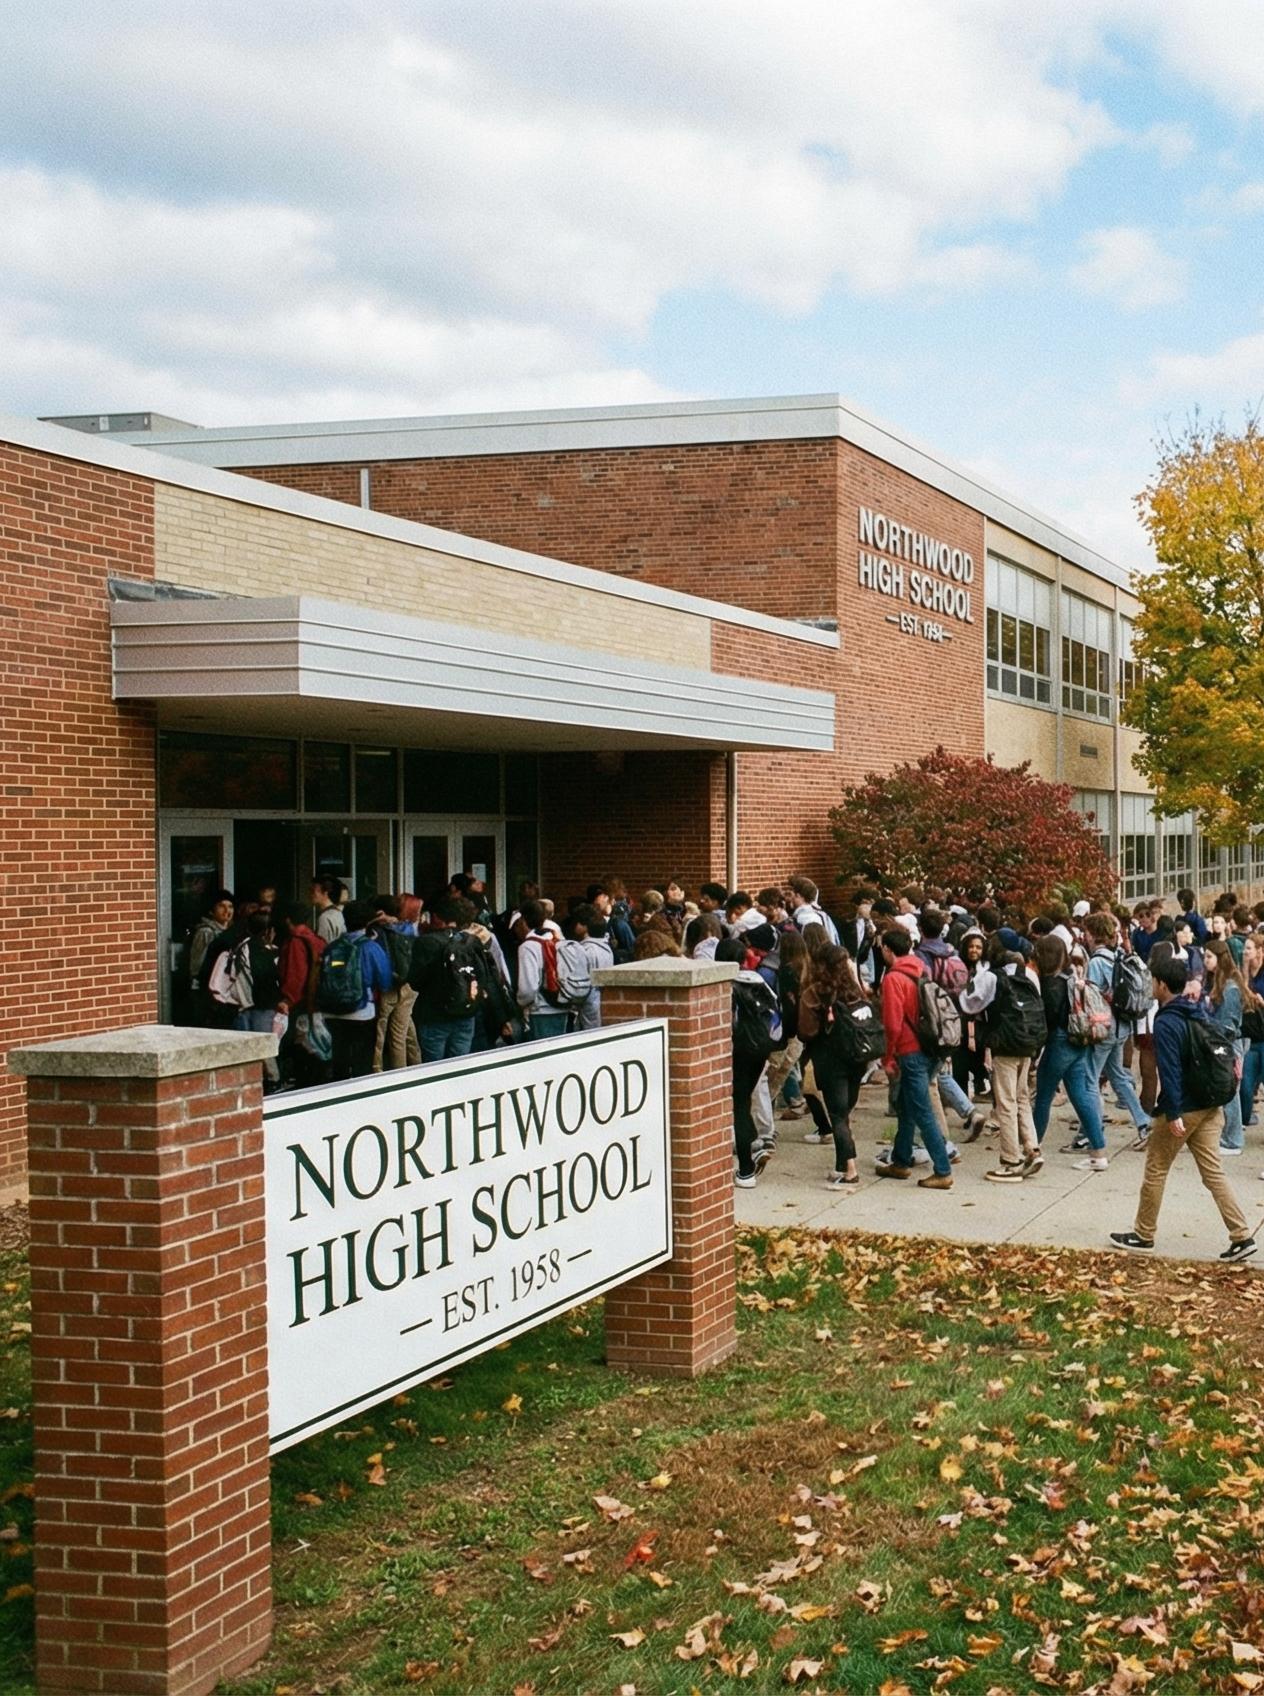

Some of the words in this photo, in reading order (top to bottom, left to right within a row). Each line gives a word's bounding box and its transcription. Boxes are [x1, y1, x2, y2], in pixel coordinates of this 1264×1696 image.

[858, 506, 974, 584] NORTHWOOD
[858, 550, 904, 598] HIGH
[909, 570, 974, 624] SCHOOL
[286, 1059, 648, 1221] NORTHWOOD
[286, 1199, 454, 1328] HIGH
[471, 1134, 653, 1258] SCHOOL
[441, 1276, 500, 1333] EST.
[511, 1247, 562, 1301] 1958
